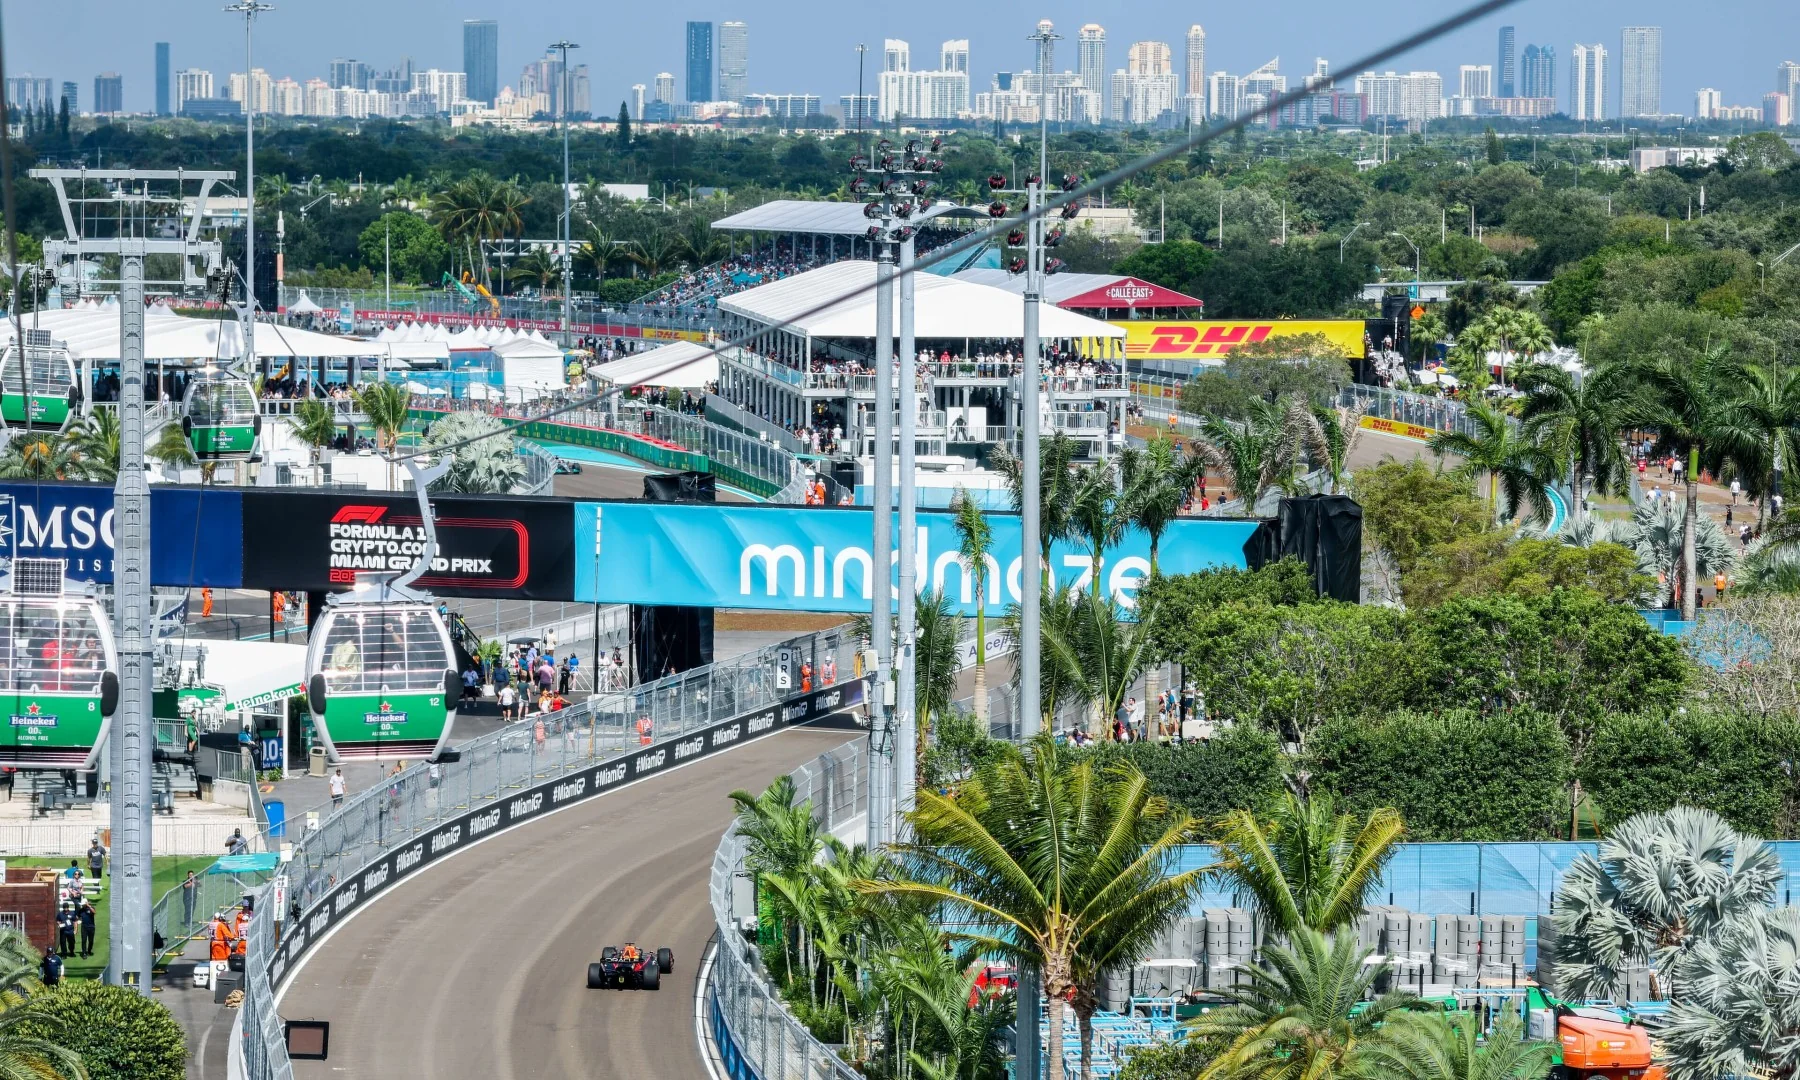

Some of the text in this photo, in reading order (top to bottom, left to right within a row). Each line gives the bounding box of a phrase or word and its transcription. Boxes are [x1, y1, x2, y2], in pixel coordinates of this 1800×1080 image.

[1111, 287, 1150, 298] CALLE EAST
[368, 311, 413, 321] Emirates
[438, 317, 472, 325] Emirates
[518, 321, 555, 330] Emirates
[1149, 326, 1273, 353] DHL
[1373, 419, 1393, 431] DHL
[1407, 426, 1426, 439] DHL
[330, 524, 414, 541] FORMULA
[330, 554, 493, 573] MIAMI GRAND PRIX
[740, 526, 1151, 609] mindmaze
[88, 701, 95, 711] 8
[233, 687, 295, 711] Heineken
[429, 697, 440, 706] 12
[11, 716, 56, 726] Heineken
[366, 713, 406, 722] Heineken
[748, 712, 774, 734] #MiamiGP
[713, 724, 741, 746] #MiamiGP
[675, 736, 703, 760] #MiamiGP
[636, 749, 666, 773] #MiamiGP
[595, 763, 627, 788] #MiamiGP
[552, 777, 586, 803] #MiamiGP
[510, 792, 543, 819] #MiamiGP
[469, 808, 500, 836] #MiamiGP
[431, 825, 460, 854] #MiamiGP
[396, 843, 423, 873] #MiamiGP
[364, 862, 389, 893] #MiamiGP
